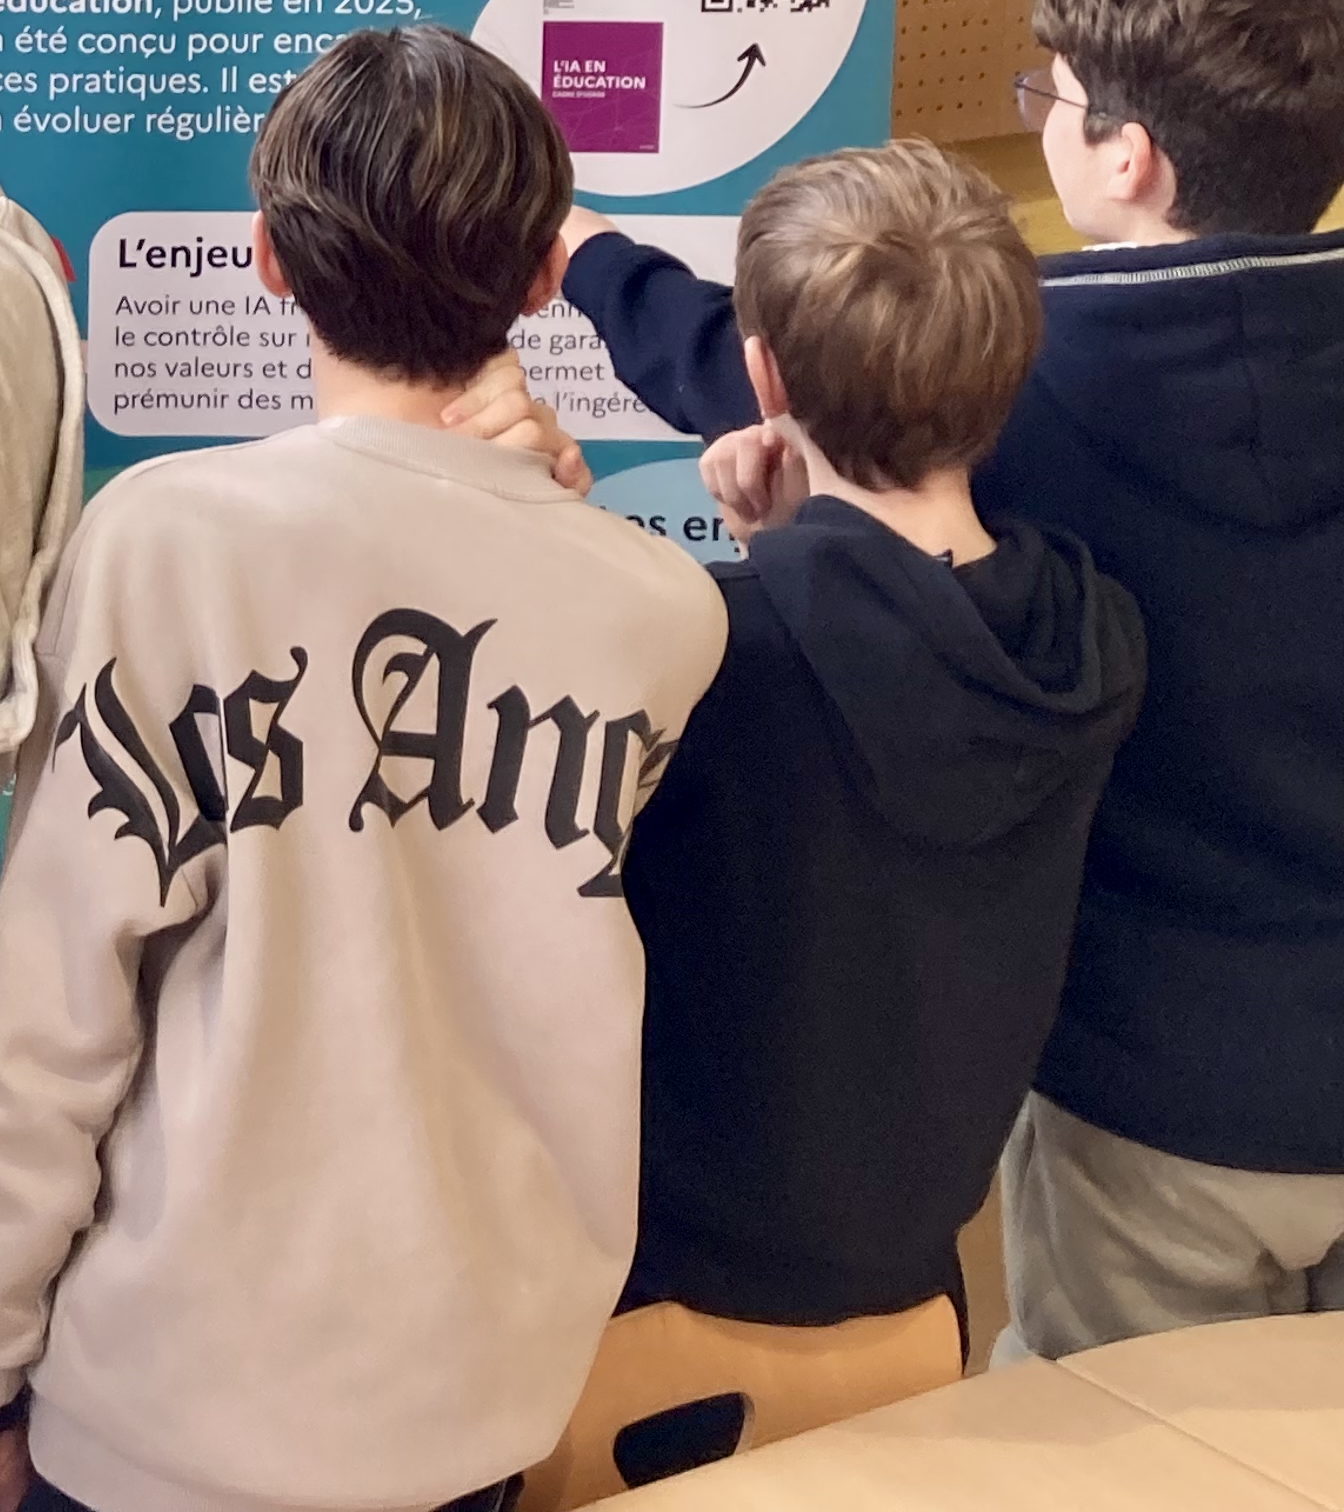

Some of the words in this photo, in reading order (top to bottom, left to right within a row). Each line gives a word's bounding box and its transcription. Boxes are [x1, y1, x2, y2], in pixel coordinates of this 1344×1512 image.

[15, 26, 67, 53] été
[78, 34, 176, 58] conçu
[188, 34, 263, 61] pour
[585, 60, 605, 72] EN
[50, 66, 208, 101] pratiques.
[222, 66, 237, 92] Il
[553, 74, 645, 89] ÉDUCATION
[14, 105, 135, 133] évoluer
[120, 237, 252, 277] L'enjeu
[116, 294, 180, 315] Avoir
[190, 300, 235, 315] une
[246, 296, 271, 315] IA
[116, 326, 135, 347] le
[144, 325, 249, 346] contrôle
[115, 363, 156, 378] nos
[165, 356, 253, 378] valeurs
[114, 388, 229, 415] prémunir
[238, 388, 281, 410] des
